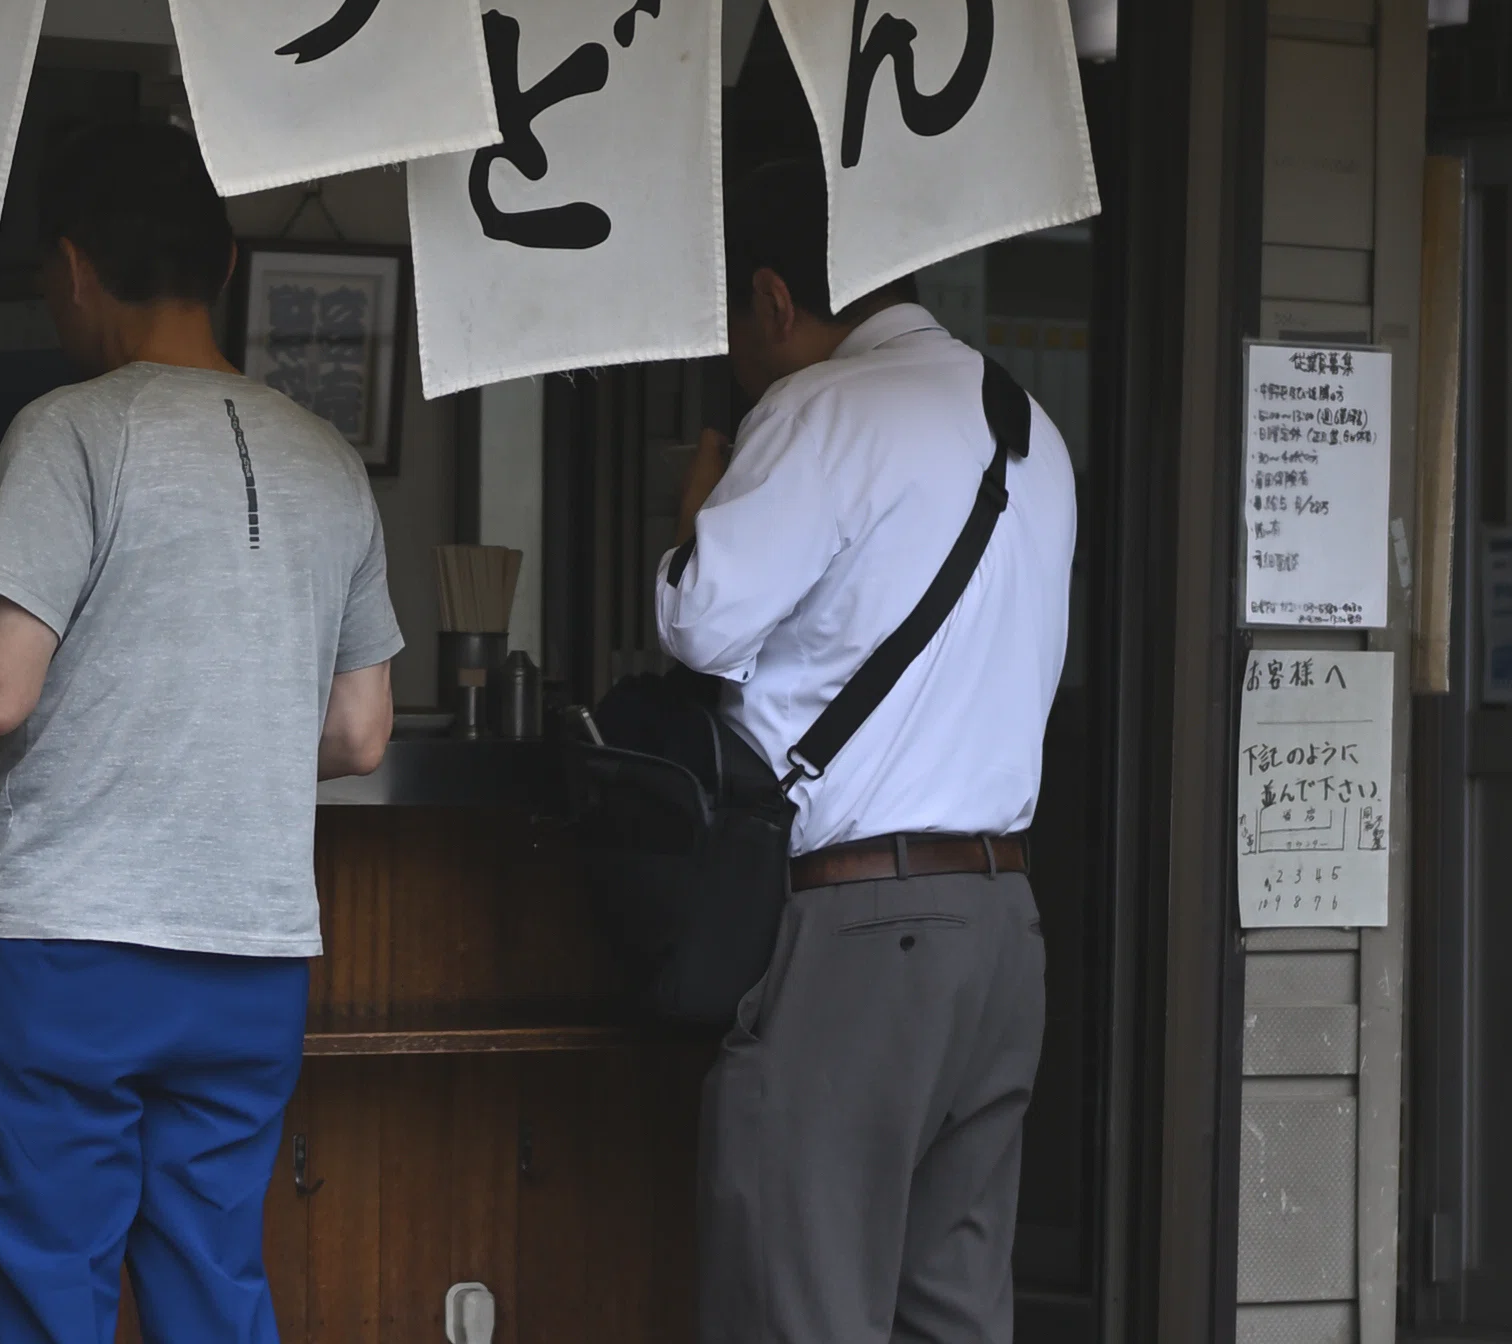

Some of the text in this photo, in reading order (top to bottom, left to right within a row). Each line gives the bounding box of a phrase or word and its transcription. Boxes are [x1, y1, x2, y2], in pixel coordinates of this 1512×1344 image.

[1246, 658, 1347, 692] お客様へ
[1242, 741, 1359, 776] 下記のように
[1275, 869, 1284, 884] 2
[1294, 867, 1302, 885] 3
[1331, 864, 1343, 881] 5
[1275, 893, 1282, 912] 9
[1293, 894, 1302, 909] 8
[1314, 895, 1322, 912] 7
[1331, 895, 1339, 911] 6
